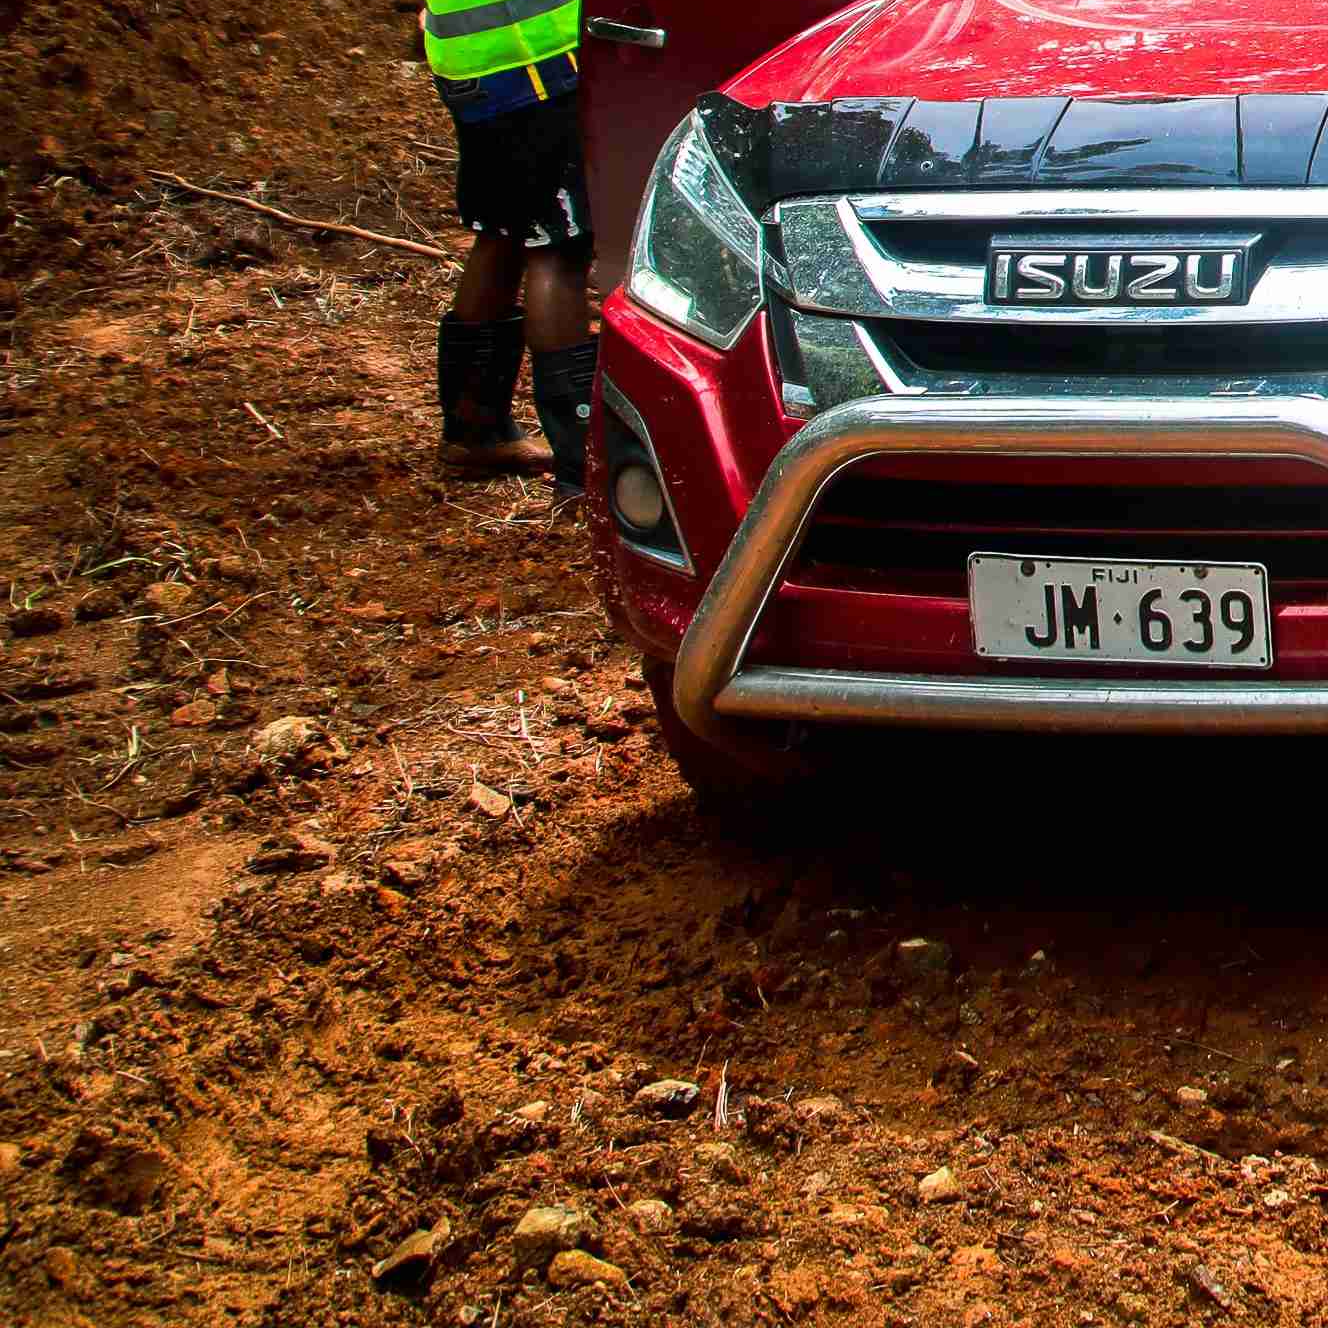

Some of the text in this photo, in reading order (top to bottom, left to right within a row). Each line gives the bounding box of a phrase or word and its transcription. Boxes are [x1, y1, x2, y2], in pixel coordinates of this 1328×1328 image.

[994, 254, 1236, 299] ISUZU
[1091, 567, 1138, 584] FIJI
[1024, 583, 1254, 654] JM 639
